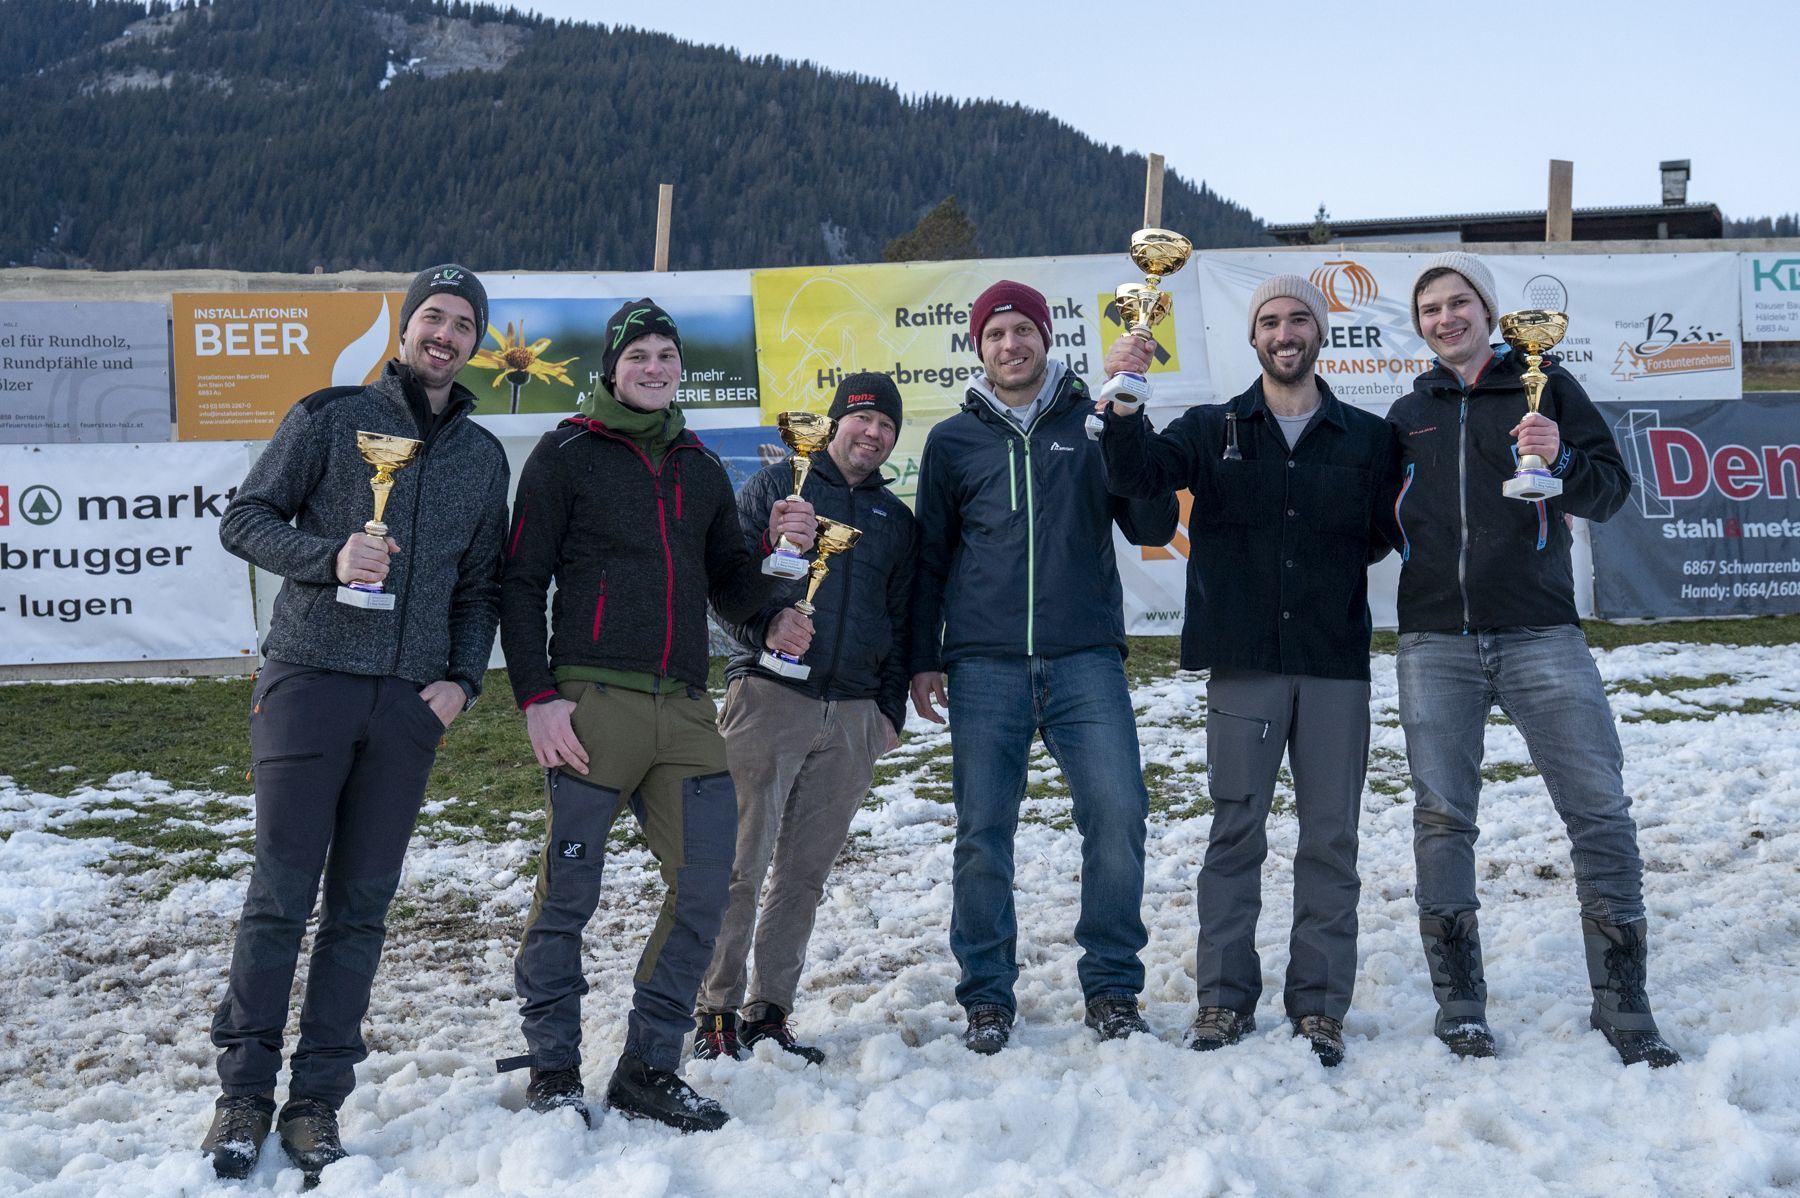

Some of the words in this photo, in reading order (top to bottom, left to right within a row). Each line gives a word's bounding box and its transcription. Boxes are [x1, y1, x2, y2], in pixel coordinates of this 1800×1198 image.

[194, 308, 308, 319] INSTALLATIONEN
[896, 296, 1084, 327] Raiffeink
[1615, 321, 1645, 329] Florian
[1635, 313, 1723, 355] Bär
[1778, 325, 1789, 333] Au
[20, 335, 44, 347] für
[49, 335, 131, 349] Rundholz,
[195, 323, 310, 356] BEER
[3, 357, 98, 372] Rundpfähle
[103, 357, 133, 369] und
[1647, 354, 1731, 370] Forstunternehmen
[691, 369, 725, 381] mehr
[715, 387, 758, 402] BEER
[1331, 382, 1403, 396] warzenberg
[0, 543, 192, 575] brugger
[1683, 561, 1716, 575] 6867
[1719, 558, 1800, 574] Schwarzenb
[1681, 583, 1730, 600] Handy:
[19, 594, 133, 622] lugen
